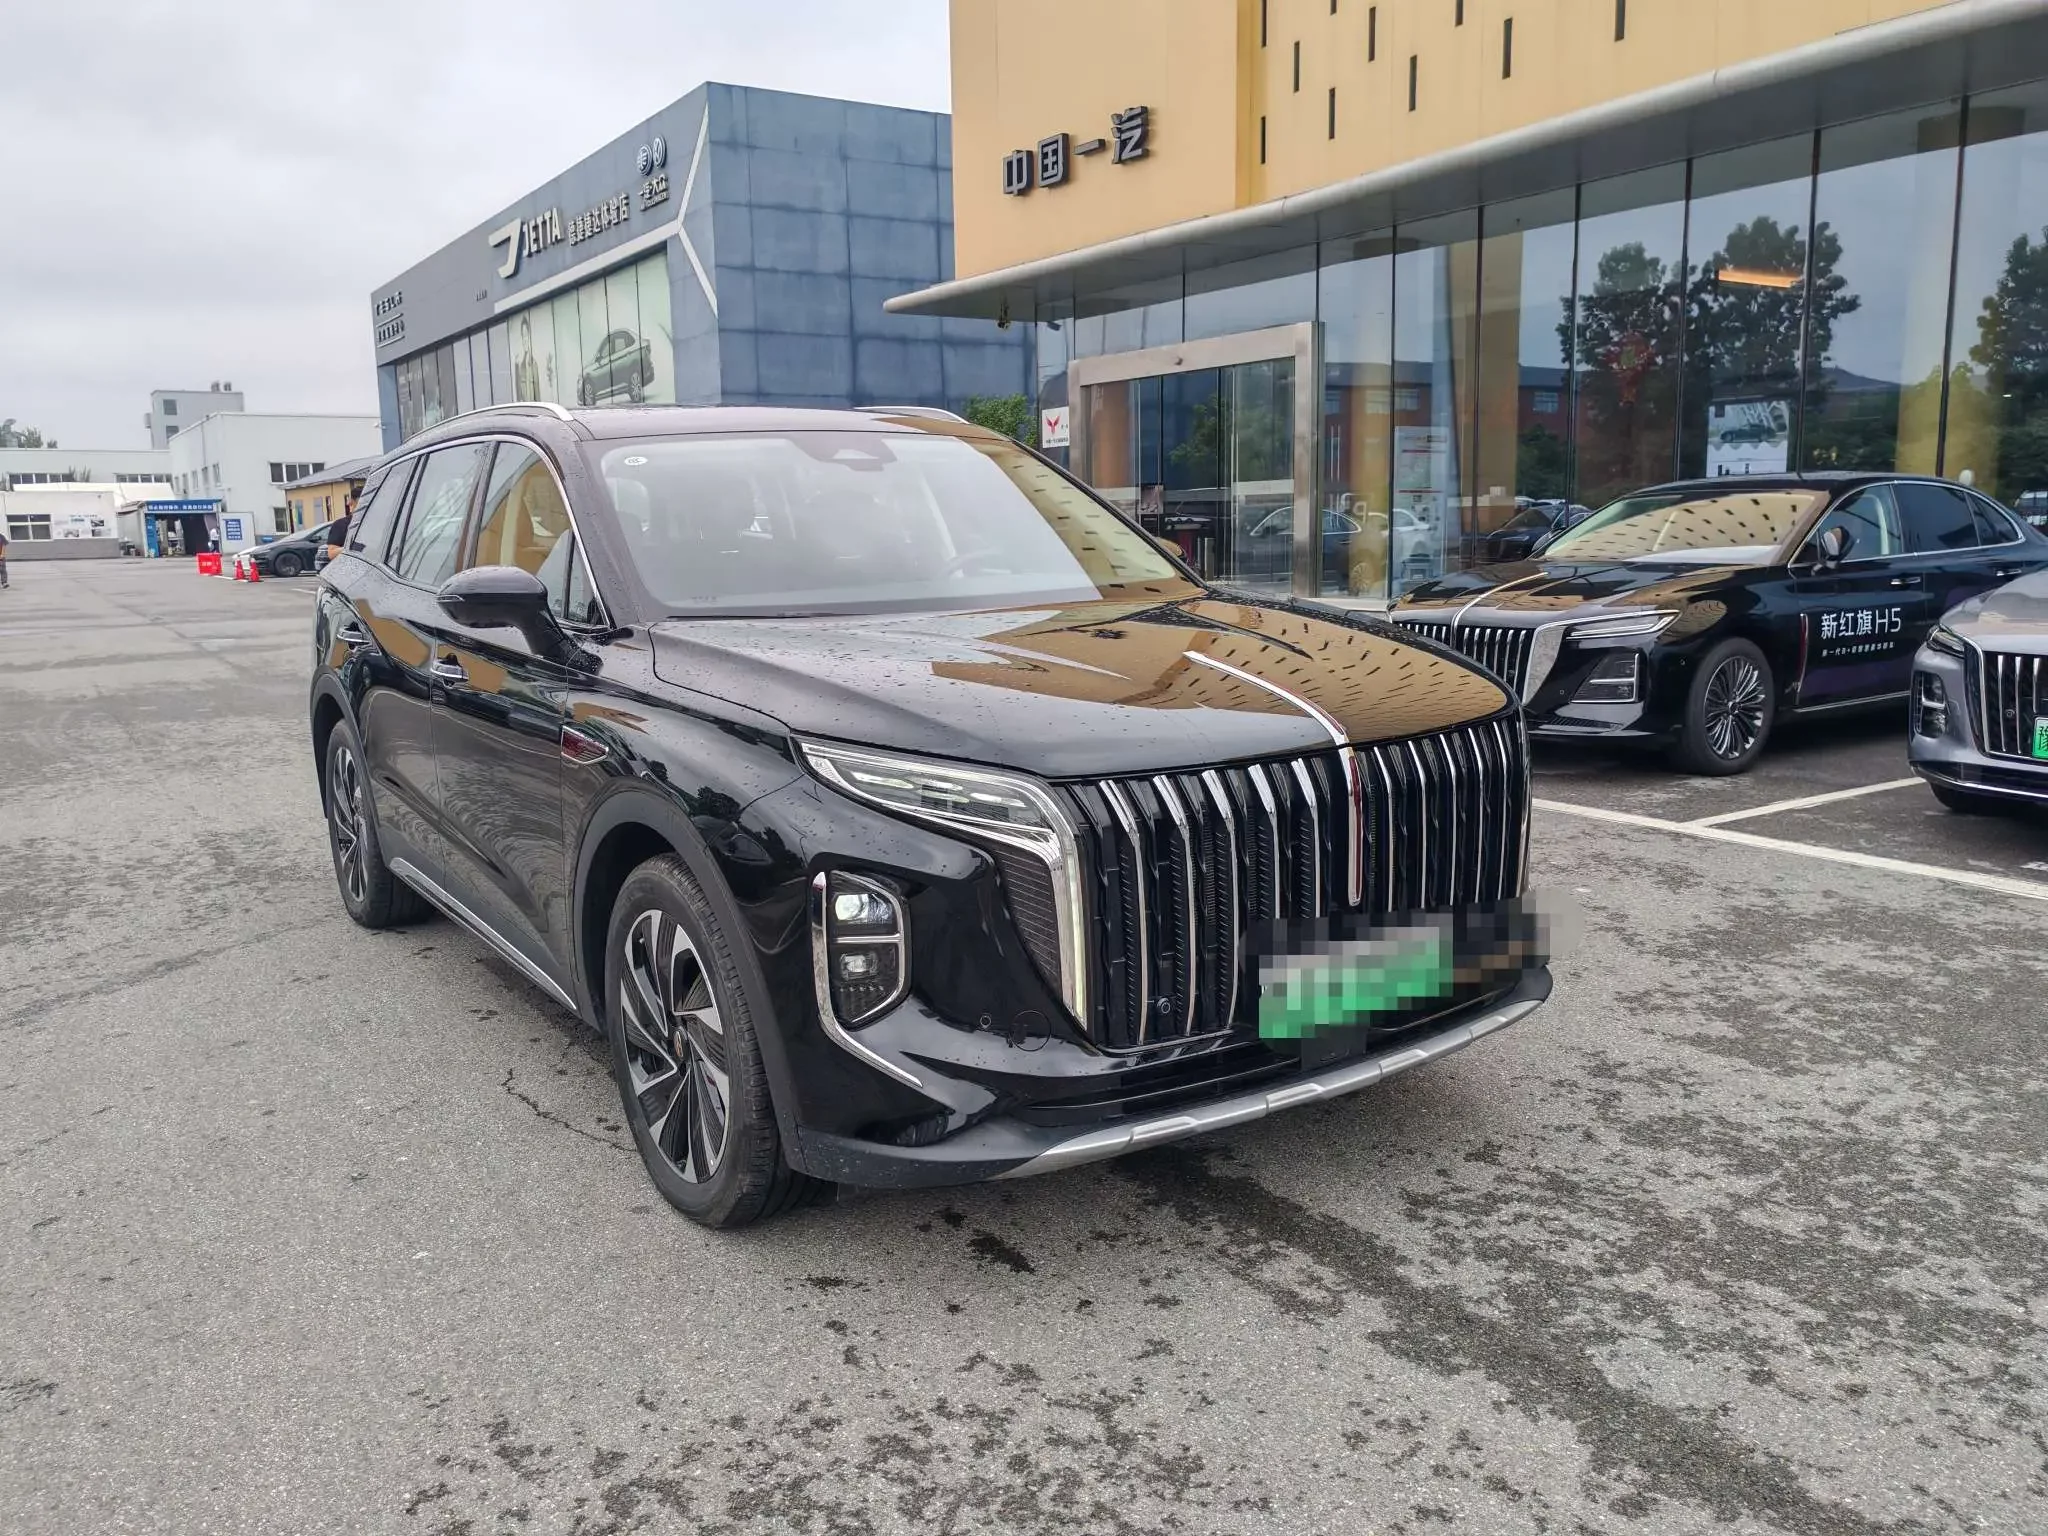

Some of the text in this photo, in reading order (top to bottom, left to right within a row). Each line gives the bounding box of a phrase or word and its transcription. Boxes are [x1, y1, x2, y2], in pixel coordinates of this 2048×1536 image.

[1003, 105, 1149, 195] 中国一汽
[522, 207, 564, 258] JETTA
